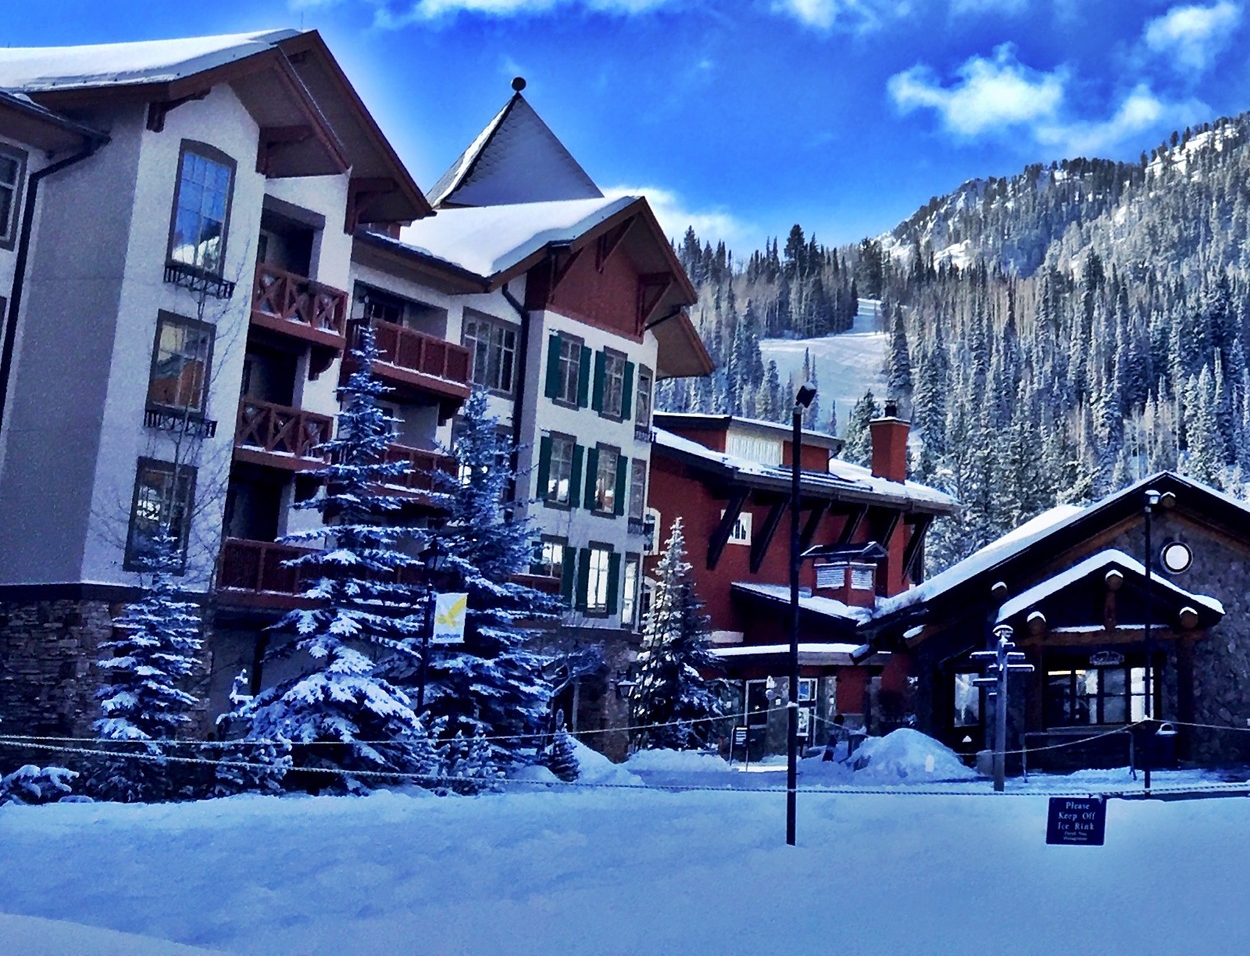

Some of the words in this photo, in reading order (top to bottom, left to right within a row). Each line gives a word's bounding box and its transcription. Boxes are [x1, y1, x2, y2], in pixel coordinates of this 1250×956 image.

[1065, 801, 1090, 810] Please
[1058, 811, 1078, 822] Keep
[1082, 811, 1096, 820] Off
[1057, 821, 1070, 830] Ice
[1074, 822, 1094, 830] Rink
